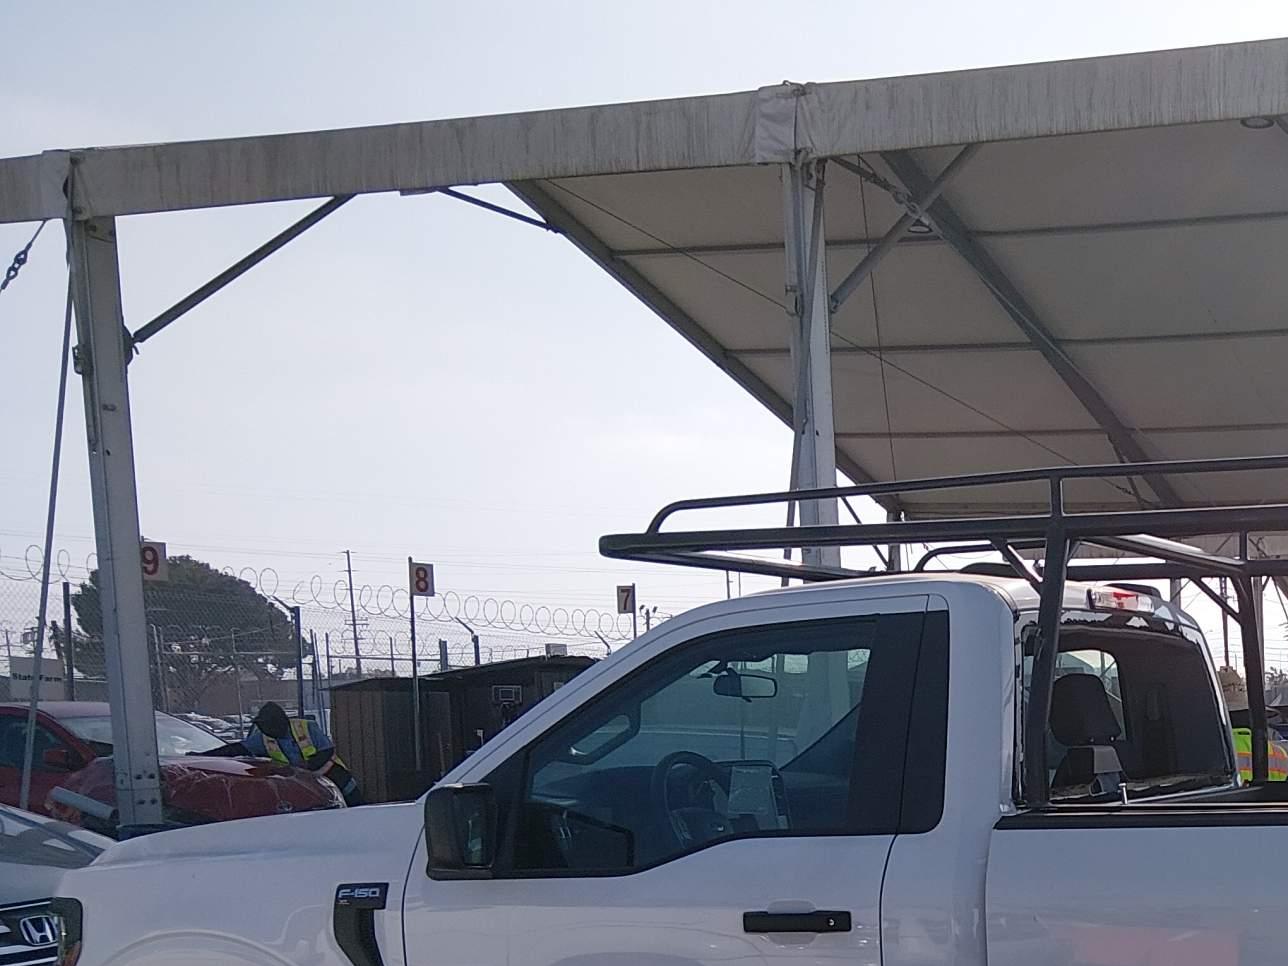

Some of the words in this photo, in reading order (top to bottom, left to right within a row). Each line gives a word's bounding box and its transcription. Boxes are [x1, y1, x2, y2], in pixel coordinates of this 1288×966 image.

[143, 546, 159, 576] 9
[415, 566, 429, 593] 8
[620, 588, 631, 611] 7
[338, 887, 380, 898] F-150
